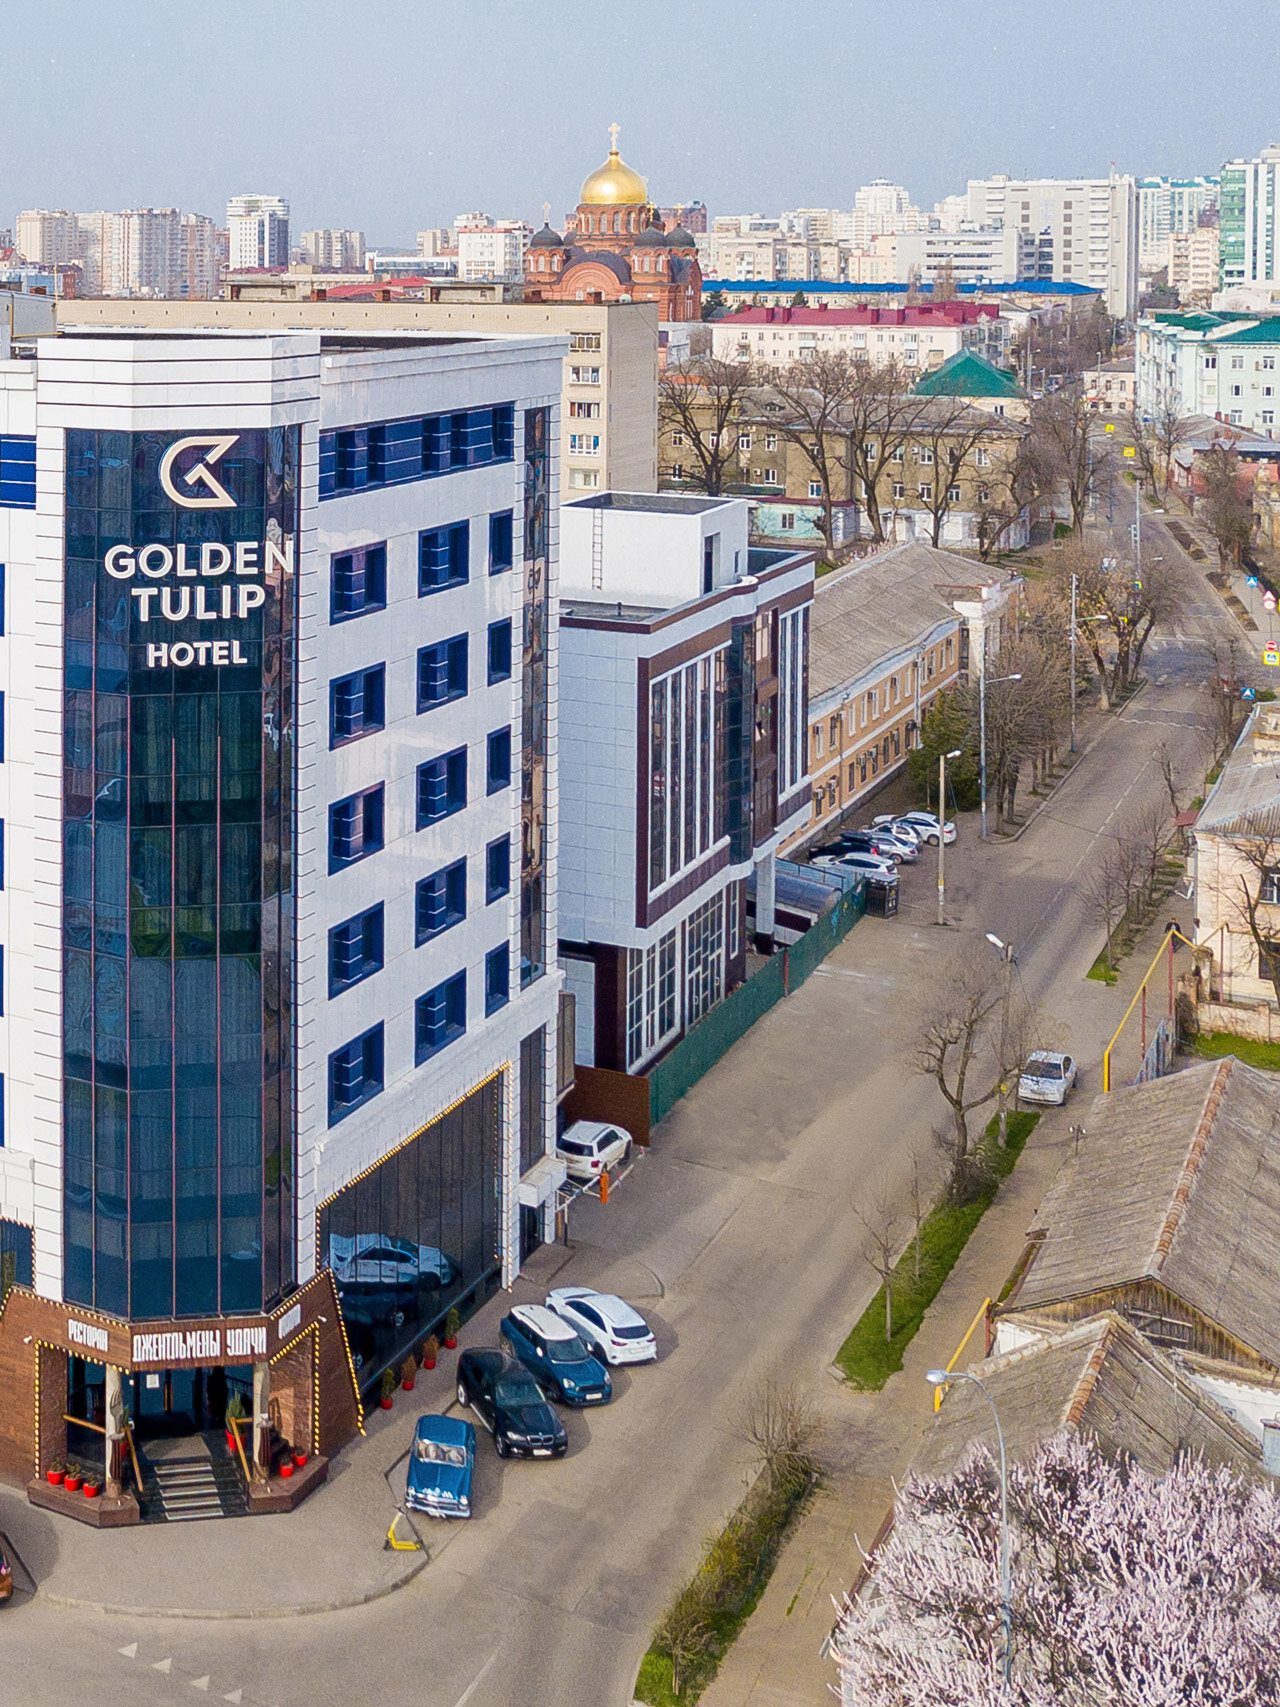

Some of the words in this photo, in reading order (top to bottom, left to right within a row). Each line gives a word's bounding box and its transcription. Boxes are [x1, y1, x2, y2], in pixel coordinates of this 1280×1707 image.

[105, 540, 294, 579] GOLDEN
[131, 584, 266, 622] TULIP
[148, 640, 248, 668] HOTEL
[68, 1318, 109, 1353] РЕСТОРАН
[132, 1329, 220, 1363] ДЖЕНТЛЬМЕНЫ
[226, 1326, 267, 1357] УДАЧИ
